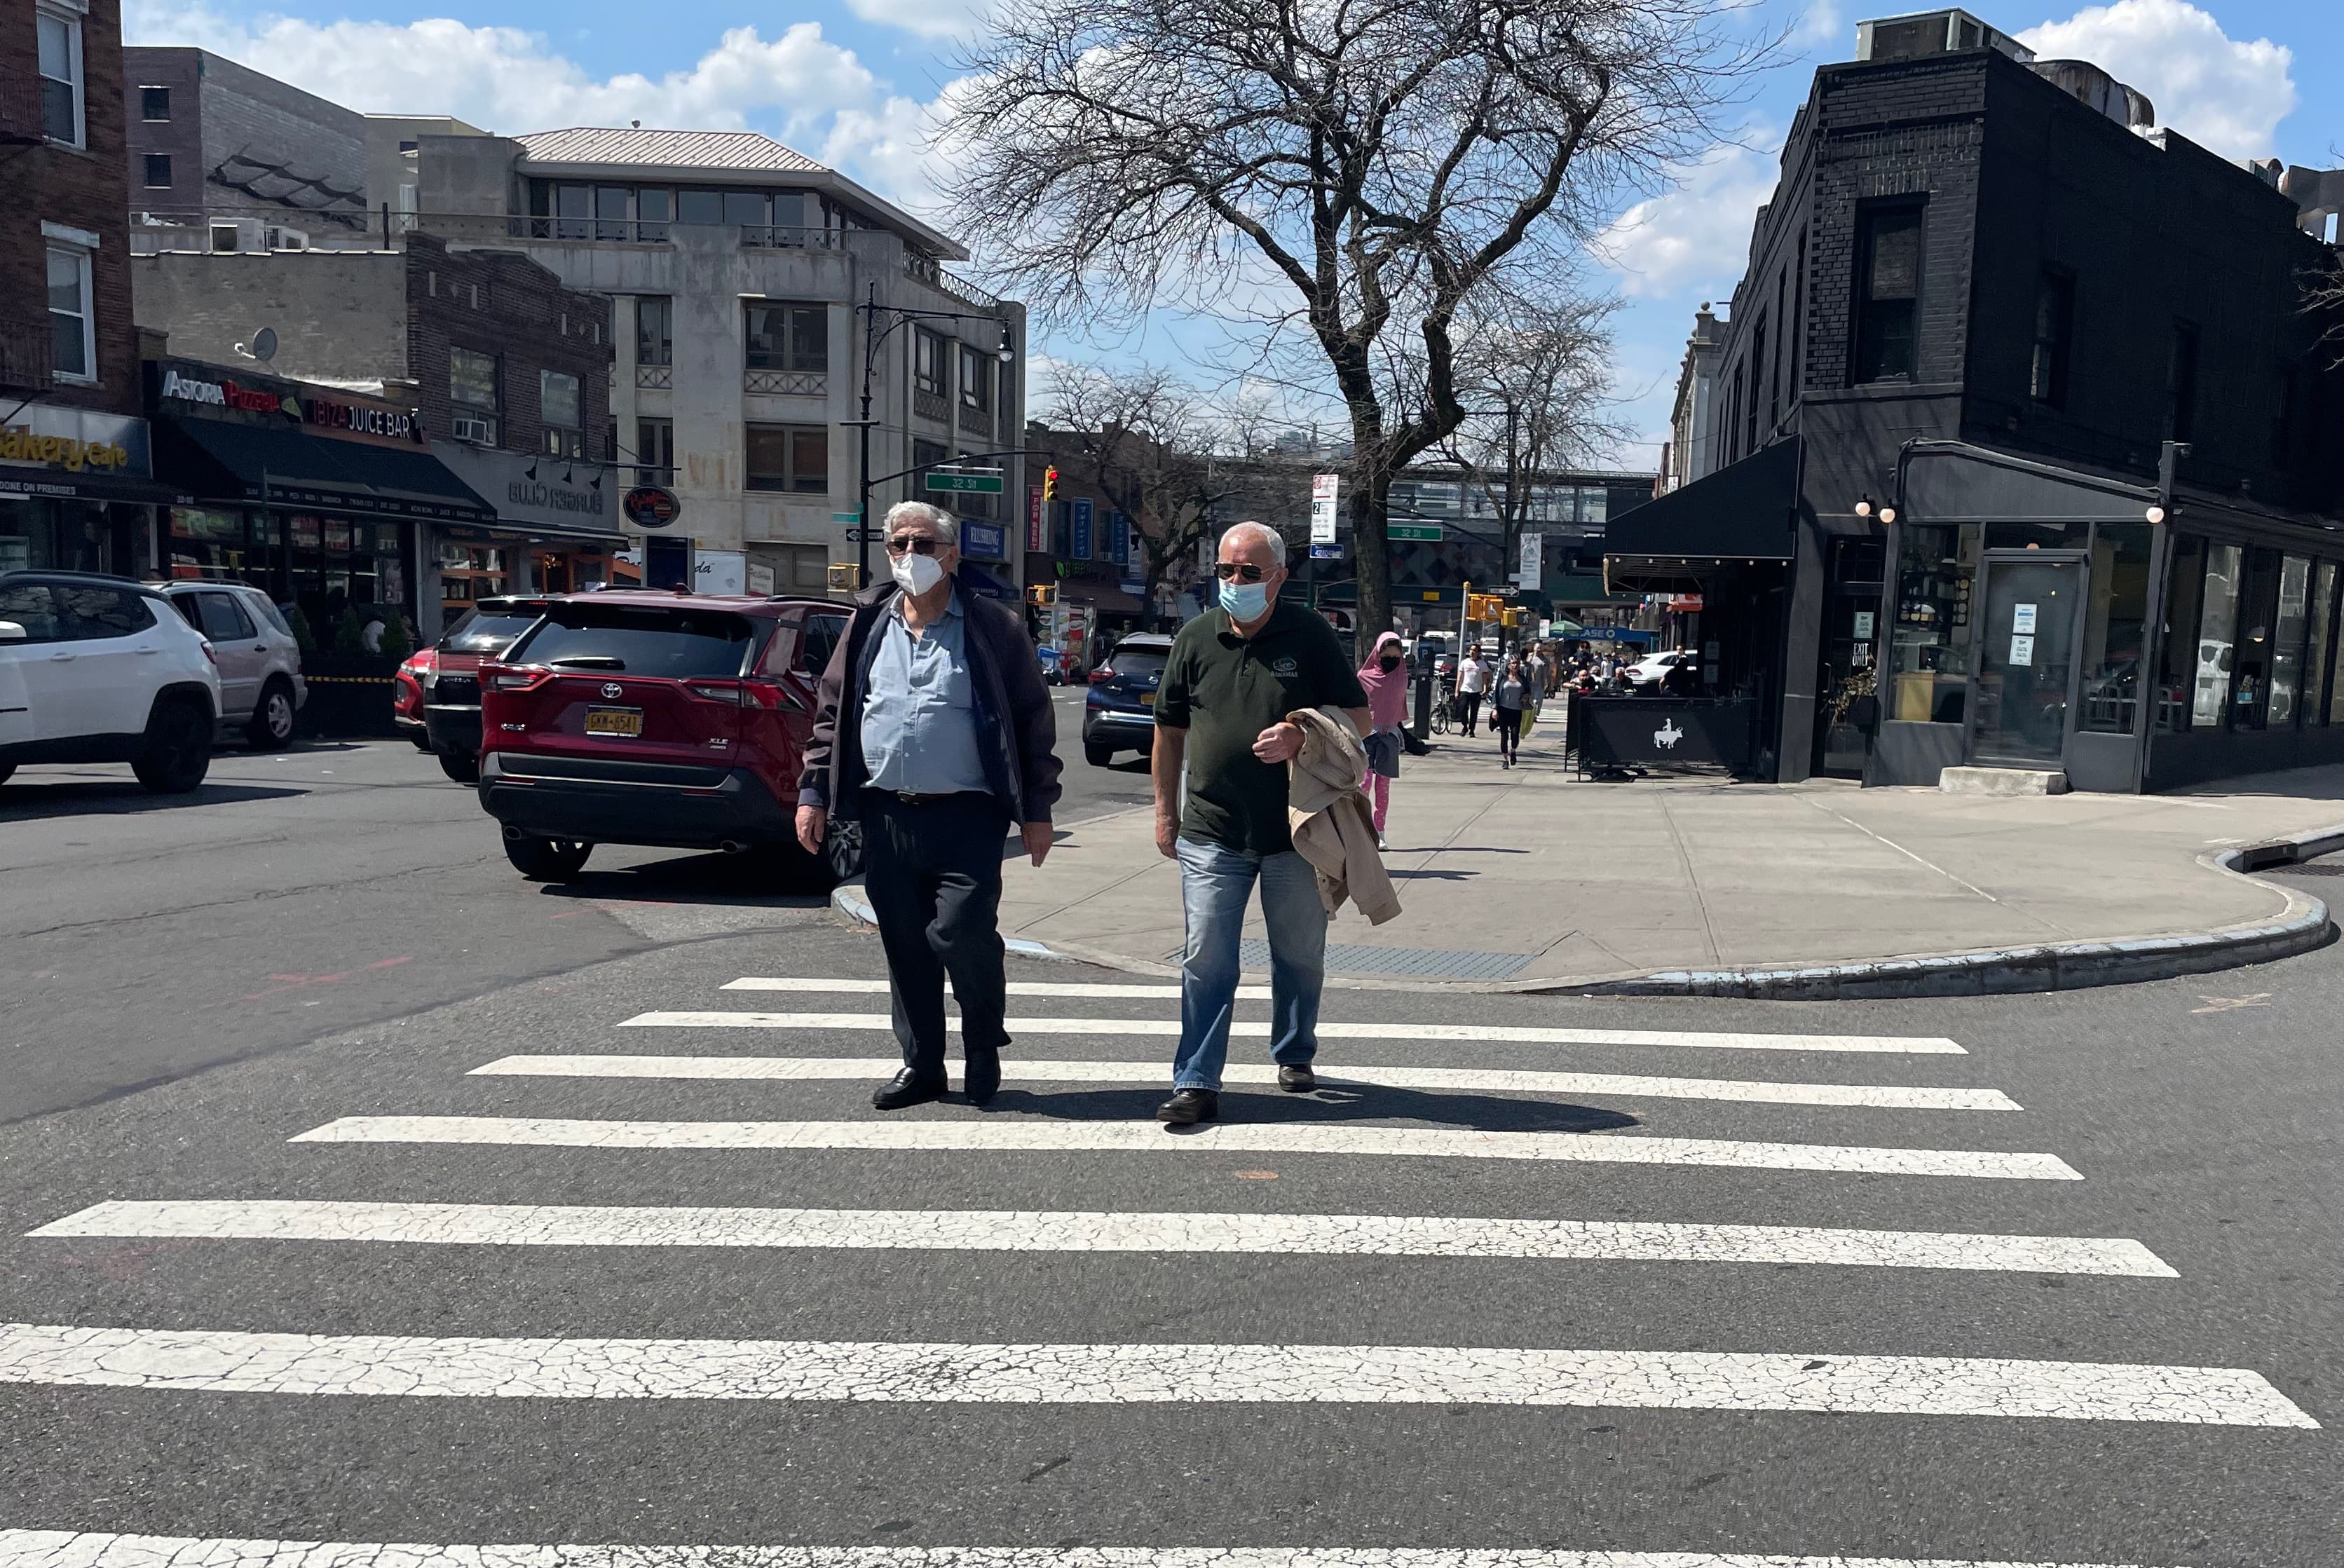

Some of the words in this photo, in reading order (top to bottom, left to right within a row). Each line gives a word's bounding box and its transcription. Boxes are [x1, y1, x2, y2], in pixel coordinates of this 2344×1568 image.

[348, 406, 383, 435] JUICE
[386, 412, 411, 439] BAR
[952, 478, 963, 489] 32
[1031, 497, 1040, 519] FOR
[969, 527, 1000, 546] FLUSHING
[1401, 529, 1411, 538] 32
[1572, 629, 1604, 638] ASE
[1853, 643, 1869, 655] EXIT
[1852, 655, 1869, 667] ONLY
